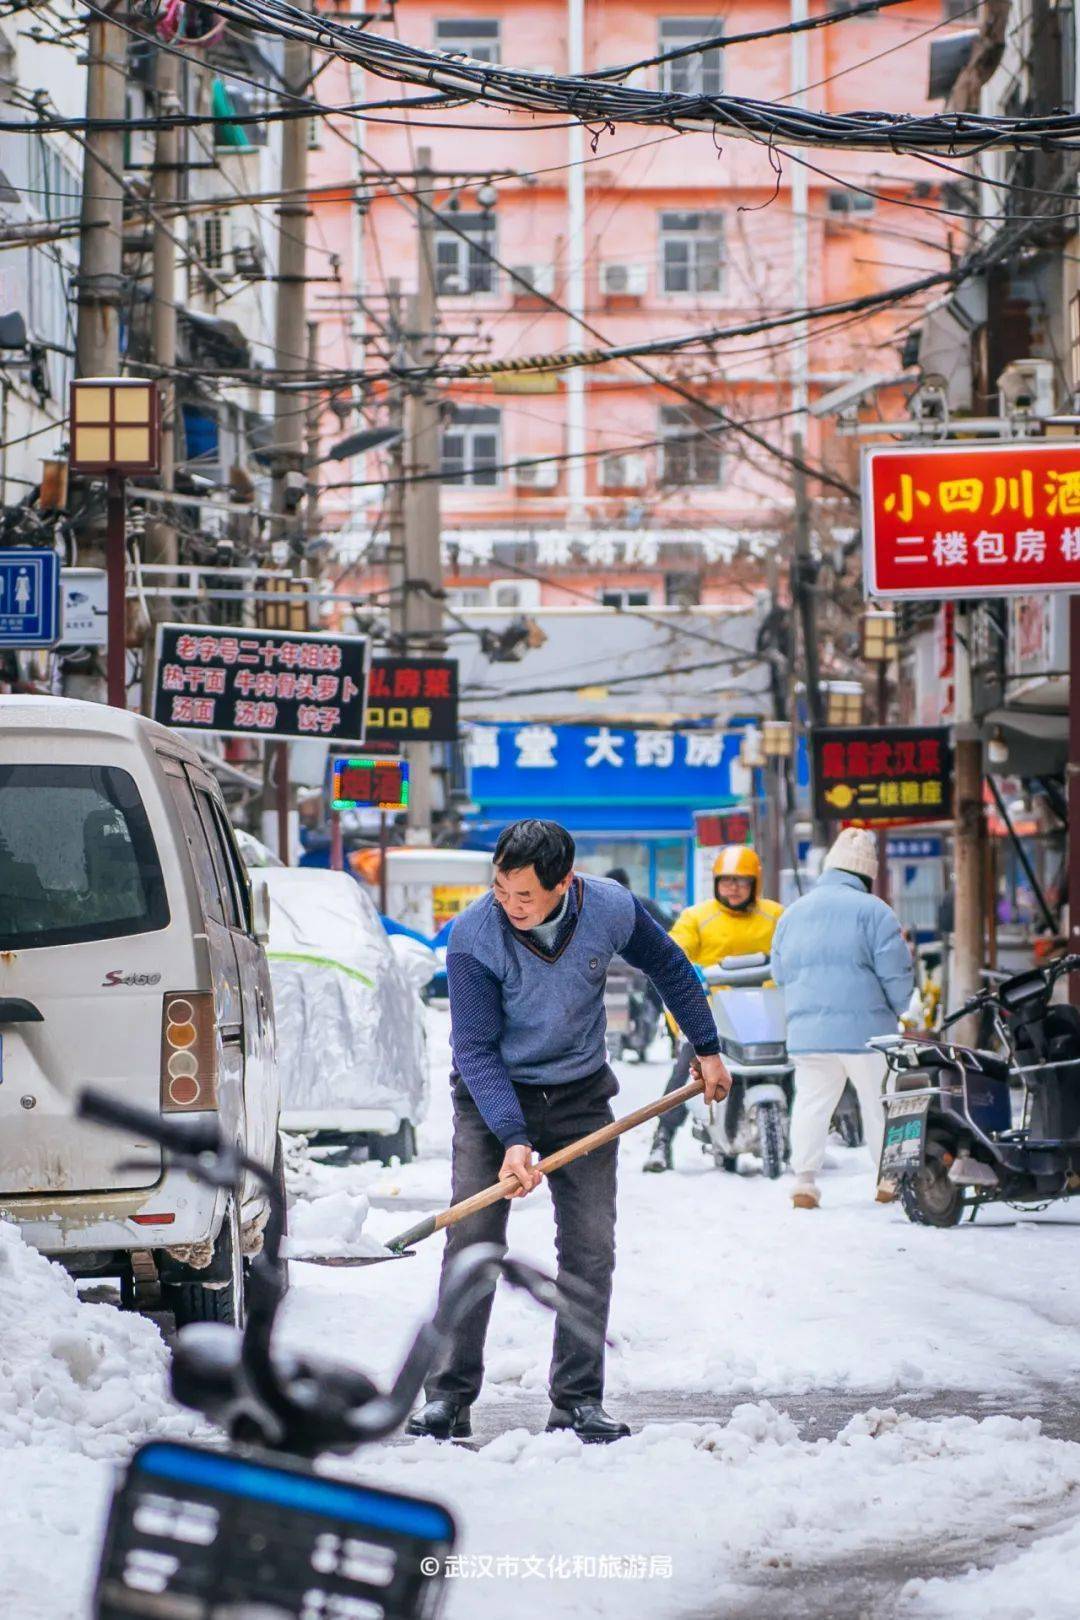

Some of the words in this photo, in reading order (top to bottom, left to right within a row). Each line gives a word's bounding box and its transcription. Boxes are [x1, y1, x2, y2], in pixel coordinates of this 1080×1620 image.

[884, 469, 1080, 523] 小四川酒
[894, 528, 1047, 567] 二楼包房
[176, 634, 342, 671] 老字号二十年姐妹
[162, 664, 227, 694] 热干面
[234, 668, 359, 703] 牛肉骨头萝卜
[171, 695, 216, 724] 汤面
[233, 700, 278, 728] 汤粉
[297, 704, 341, 732] 饺子
[584, 727, 724, 768] 大药房
